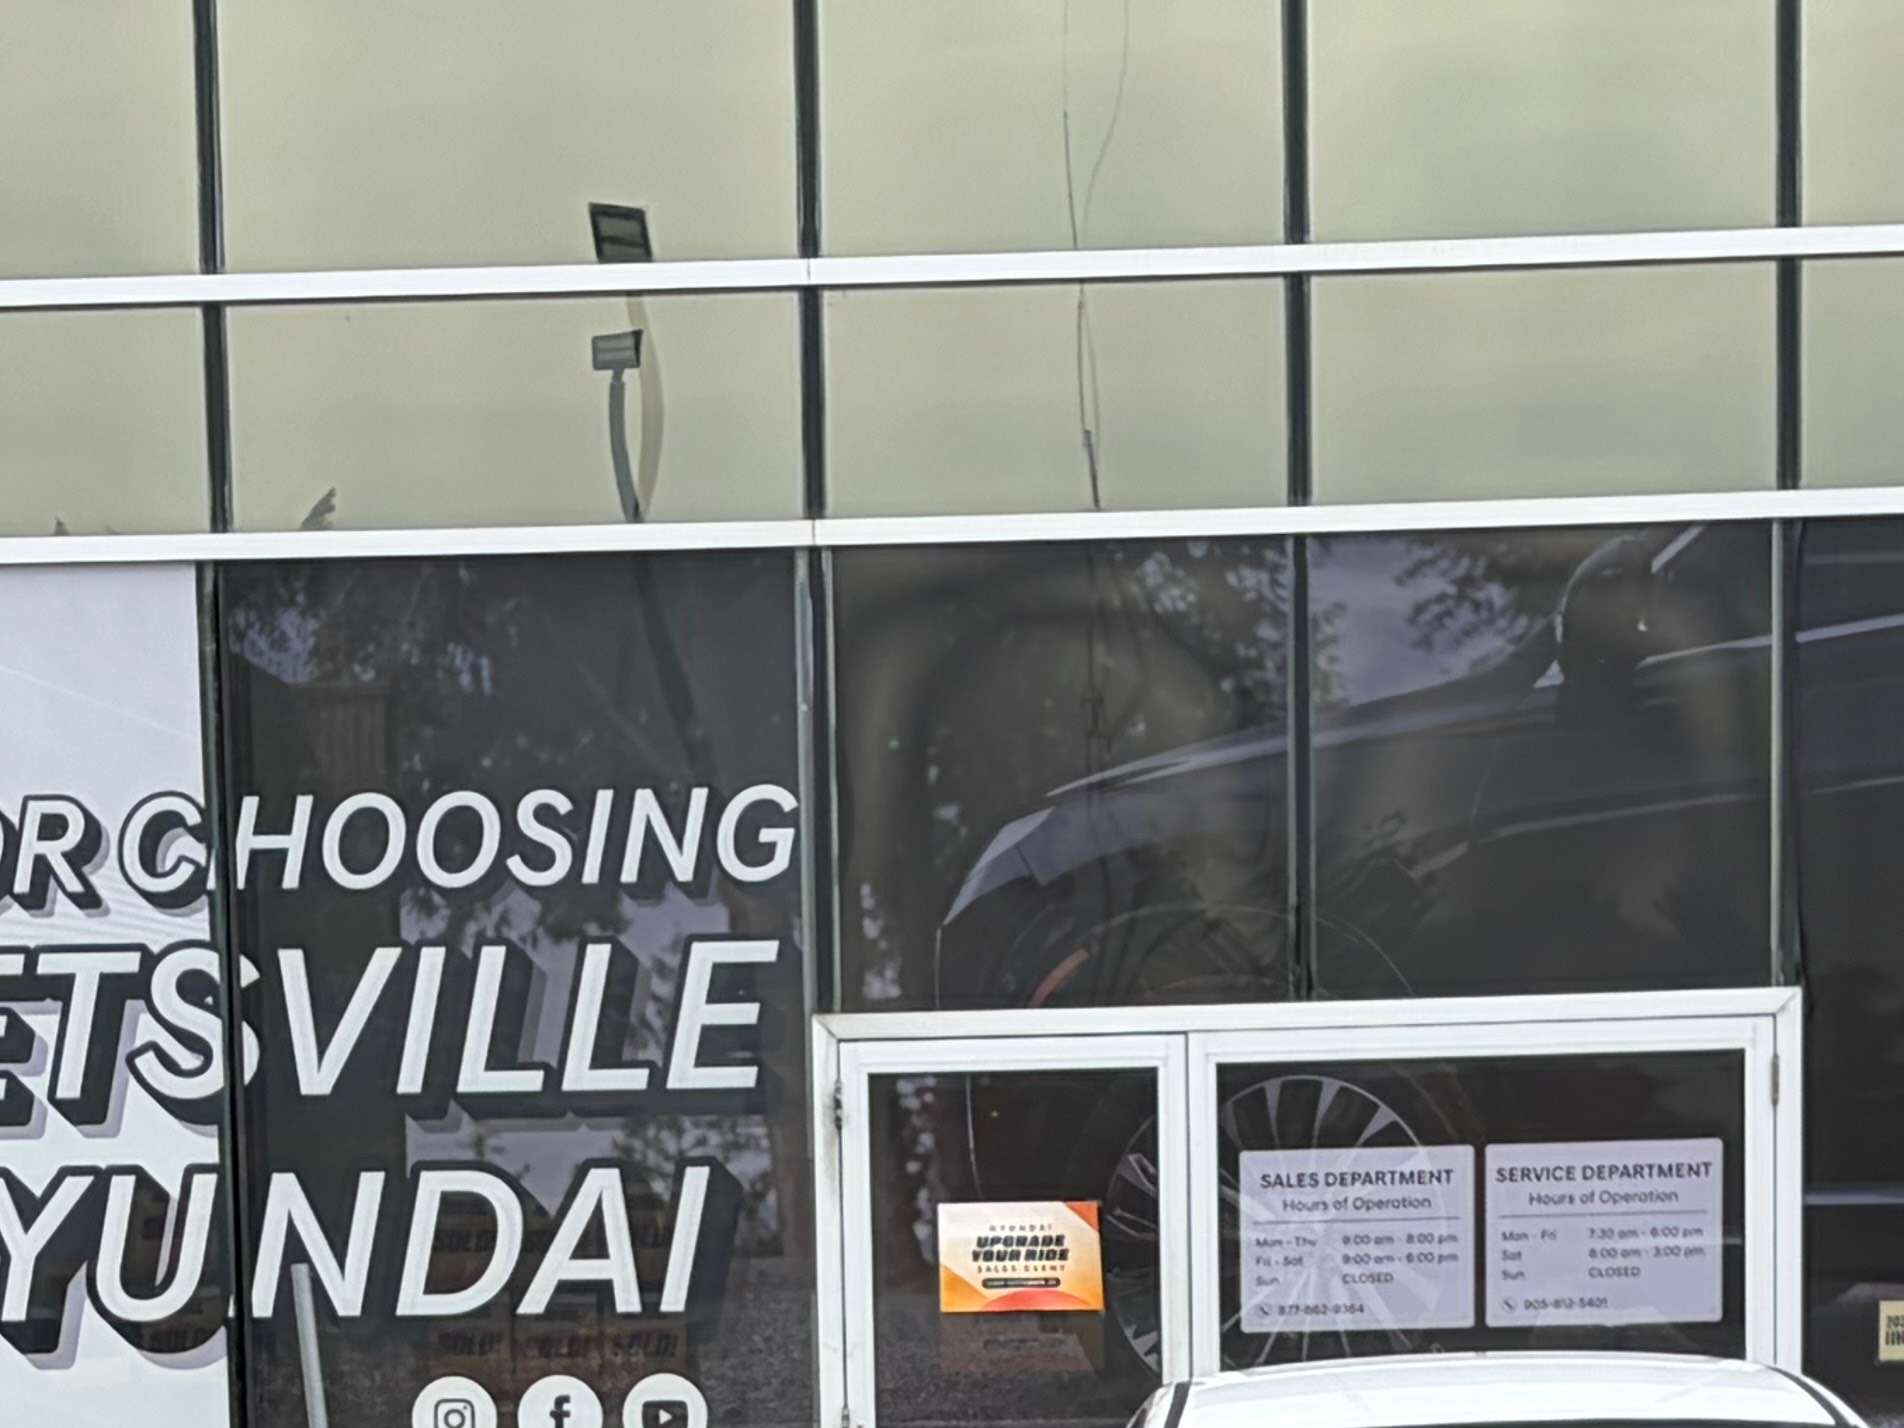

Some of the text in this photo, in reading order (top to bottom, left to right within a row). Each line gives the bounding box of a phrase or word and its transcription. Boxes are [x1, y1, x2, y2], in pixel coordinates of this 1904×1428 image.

[118, 783, 801, 905] CHOOSING
[1260, 1168, 1453, 1188] SALES DEPARTMENT
[1495, 1161, 1712, 1183] SERVICE DEPARTMENT
[1283, 1196, 1432, 1212] Hours of Operation
[1528, 1190, 1679, 1206] Hours of Operation
[976, 1235, 1066, 1248] UPGRADE
[1255, 1237, 1283, 1247] Mon
[1296, 1236, 1318, 1247] Thu
[1437, 1234, 1459, 1246] pm
[1501, 1230, 1529, 1241] Mon
[1540, 1229, 1557, 1240] Fri
[1617, 1229, 1639, 1238] am
[1682, 1228, 1704, 1240] pm
[972, 1249, 1069, 1262] YOUR RIDE
[1283, 1256, 1304, 1267] Sat
[1375, 1255, 1395, 1264] am
[1437, 1253, 1459, 1265] pm
[1501, 1250, 1522, 1261] Sat
[1620, 1249, 1641, 1258] am
[1684, 1247, 1706, 1259] pm
[1255, 1272, 1394, 1286] Sun CLOSED
[1501, 1267, 1641, 1280] Sun CLOSED
